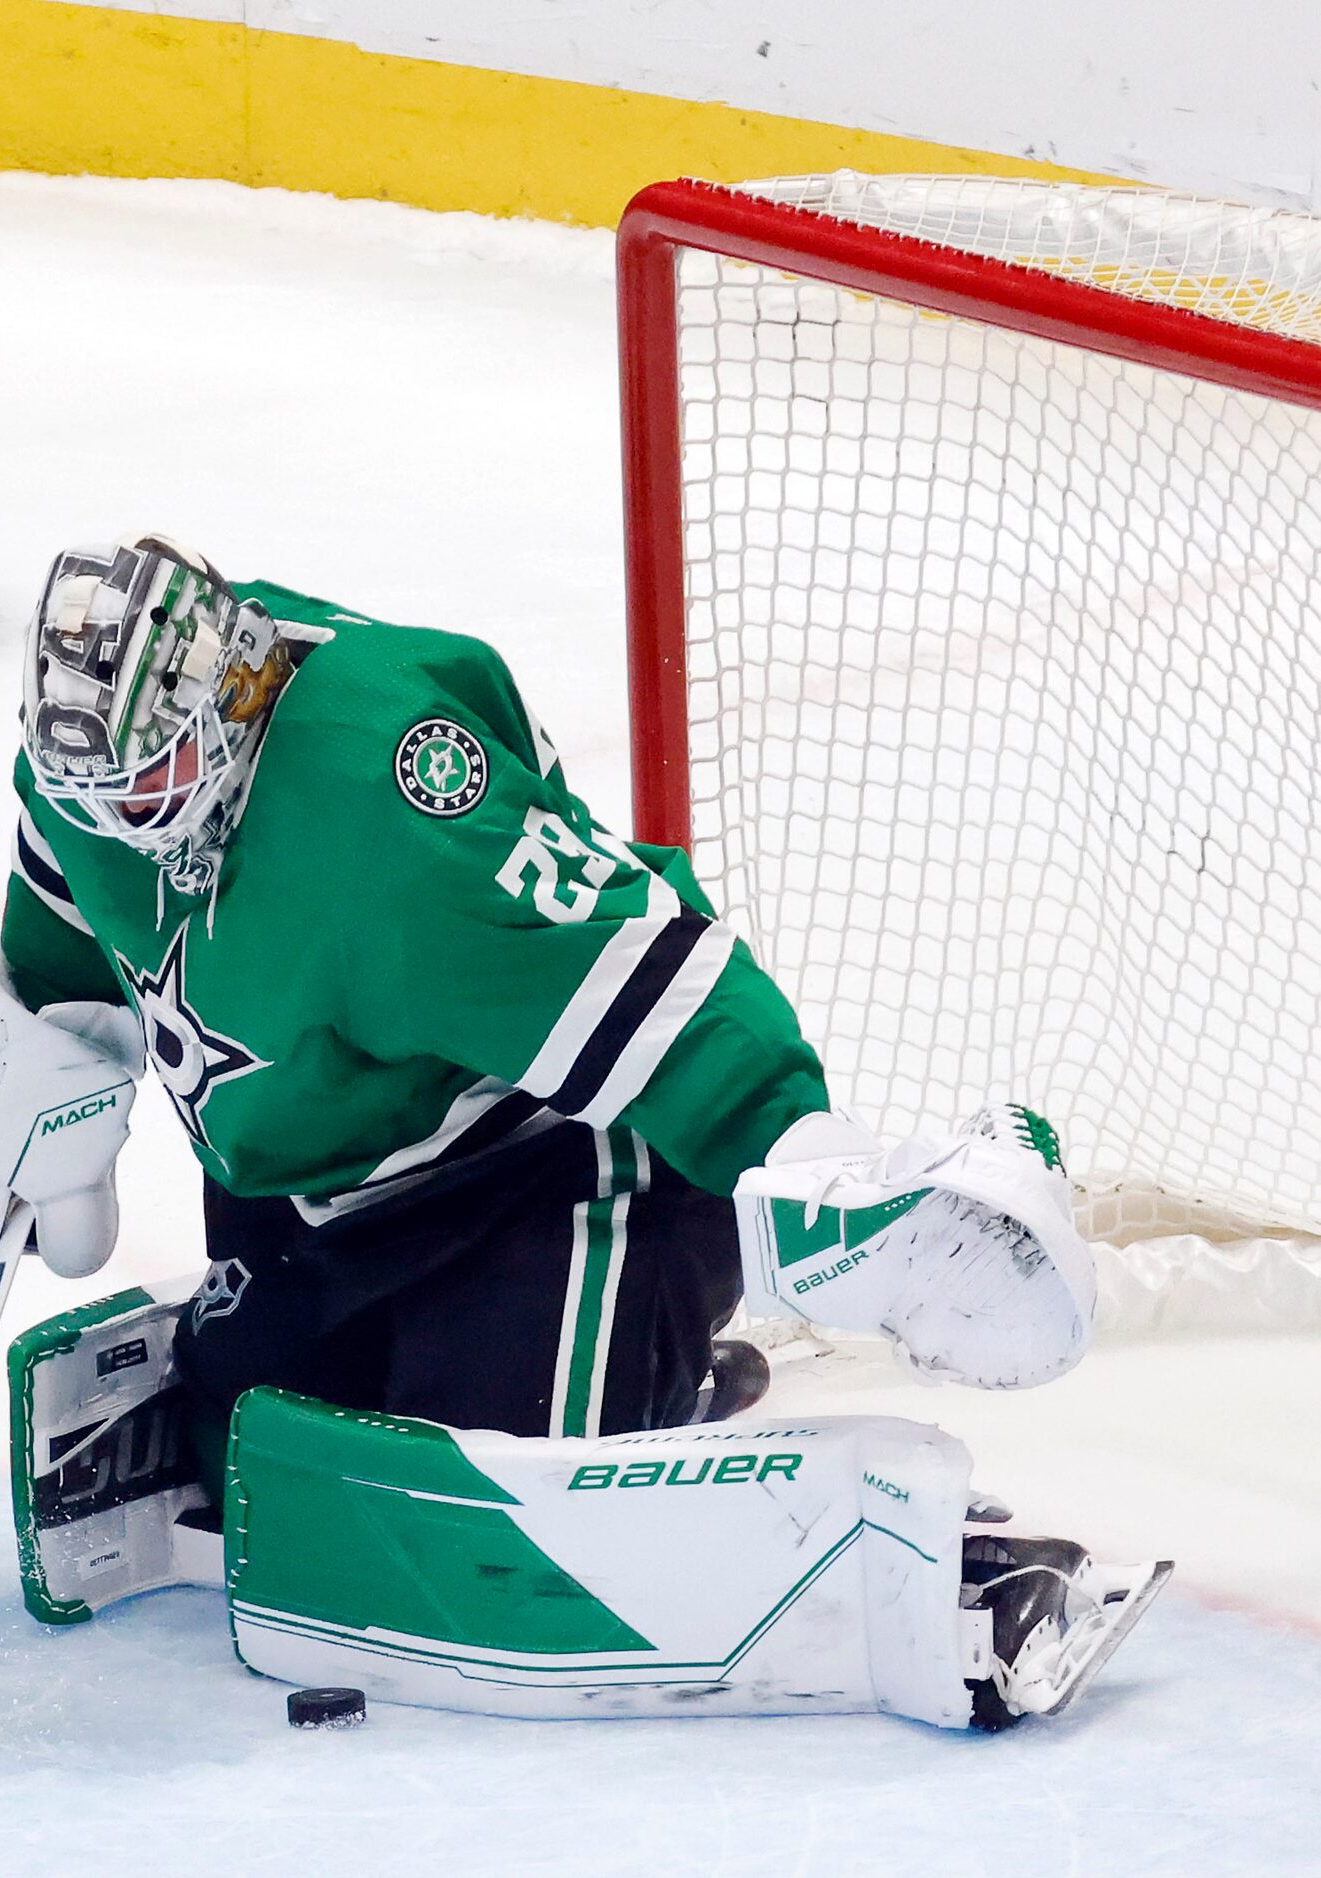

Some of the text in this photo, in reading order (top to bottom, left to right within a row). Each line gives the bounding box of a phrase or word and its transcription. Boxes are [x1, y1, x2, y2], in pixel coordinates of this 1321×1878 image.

[400, 723, 483, 811] DALLAS STARS
[41, 1094, 117, 1136] MACH
[792, 1249, 870, 1295] BAUER
[566, 1453, 803, 1491] BAUER
[862, 1469, 910, 1505] MACH
